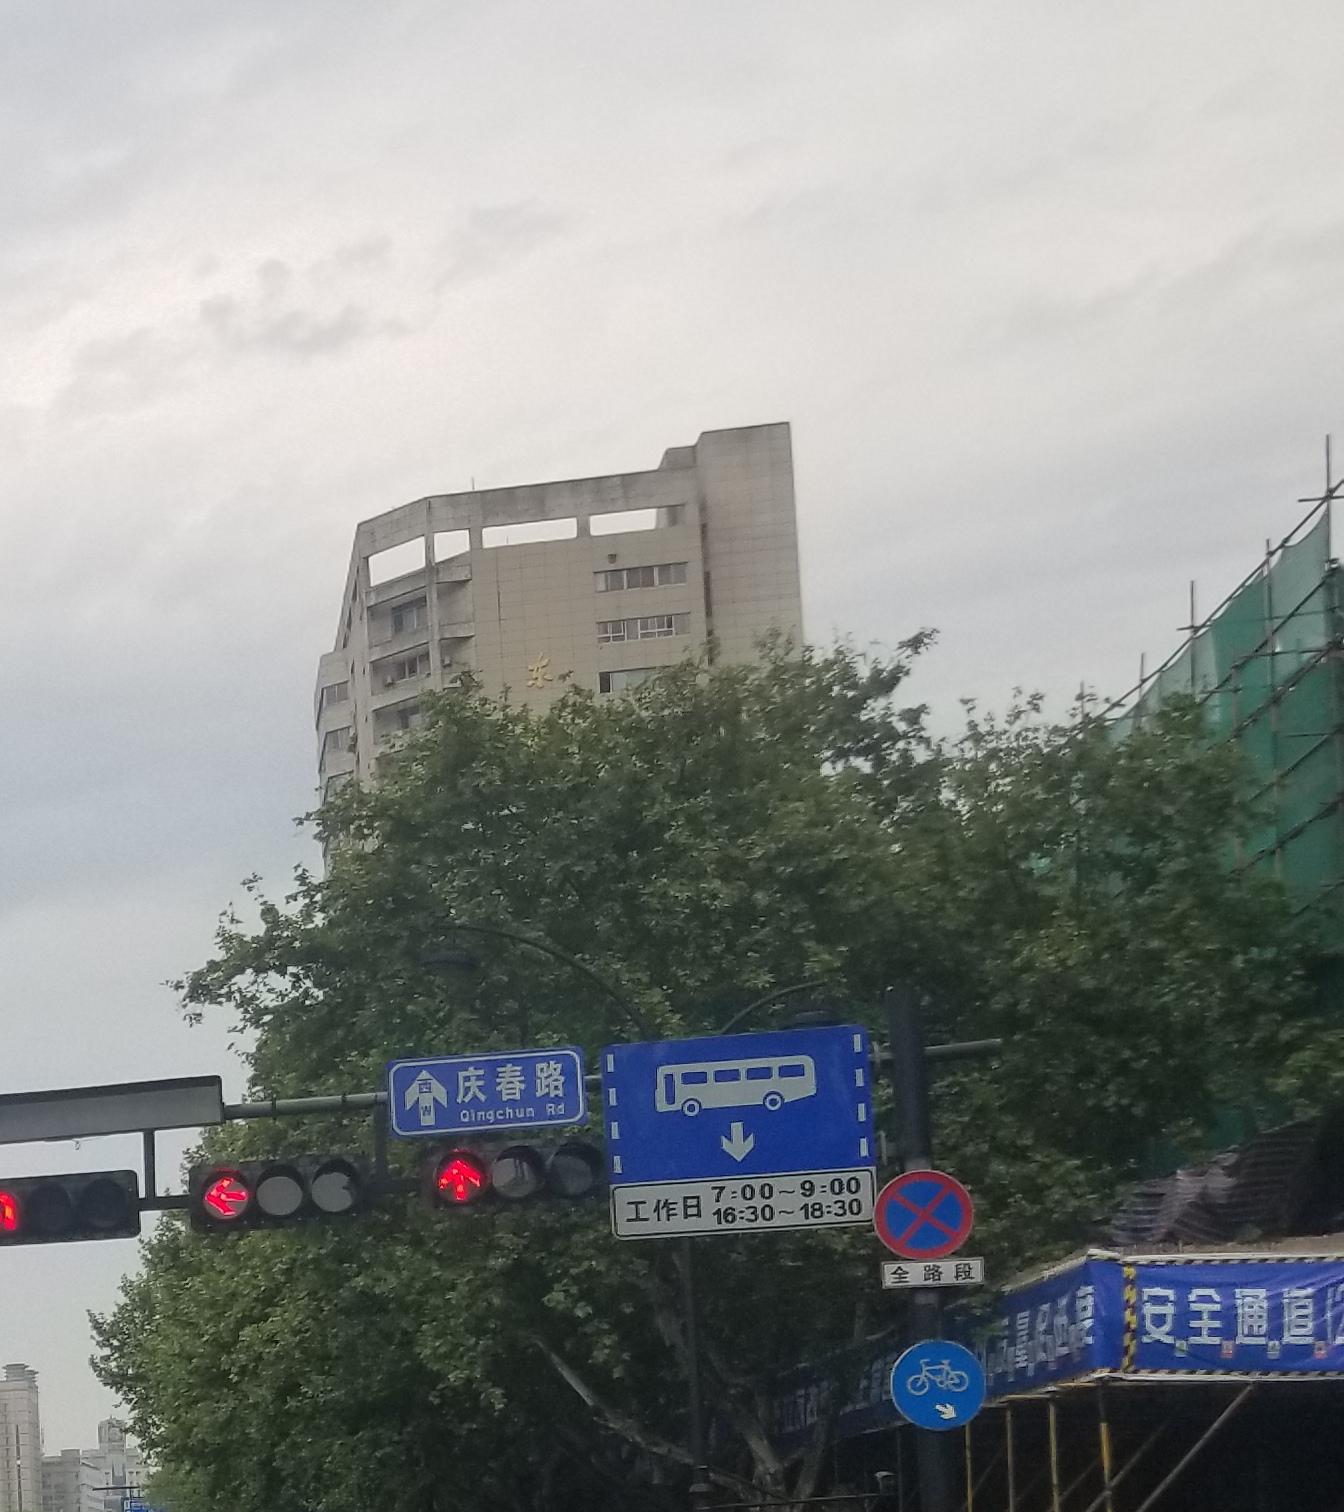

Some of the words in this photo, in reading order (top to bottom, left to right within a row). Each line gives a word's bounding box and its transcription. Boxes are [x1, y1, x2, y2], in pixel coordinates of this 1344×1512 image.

[456, 1061, 565, 1104] 庆春路
[460, 1106, 535, 1124] Qingchun
[545, 1103, 565, 1116] Rd
[625, 1195, 702, 1223] 工作日
[889, 1262, 975, 1284] 全路段
